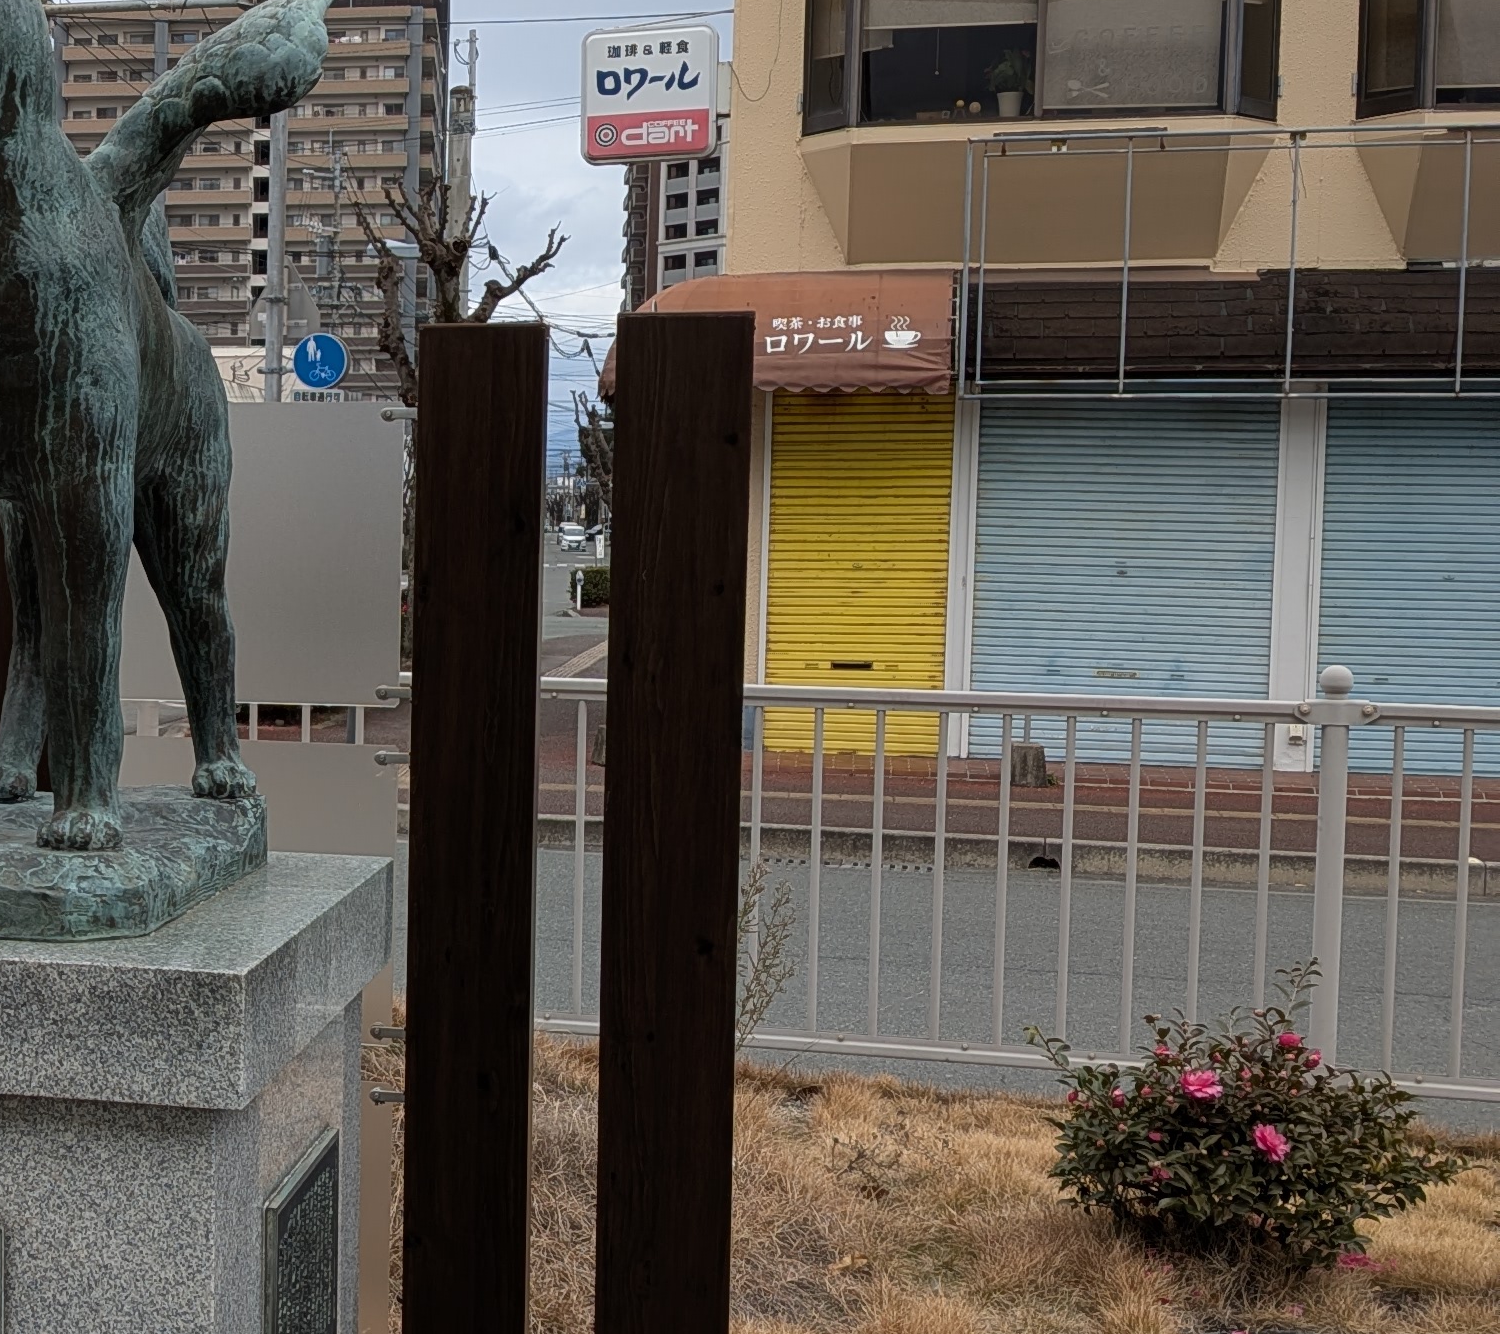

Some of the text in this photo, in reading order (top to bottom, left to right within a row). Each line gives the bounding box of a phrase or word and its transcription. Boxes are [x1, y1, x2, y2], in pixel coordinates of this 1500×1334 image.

[596, 60, 701, 101] ロワール
[621, 119, 699, 146] dart
[647, 118, 687, 127] COFFEE
[764, 331, 874, 354] ロワール
